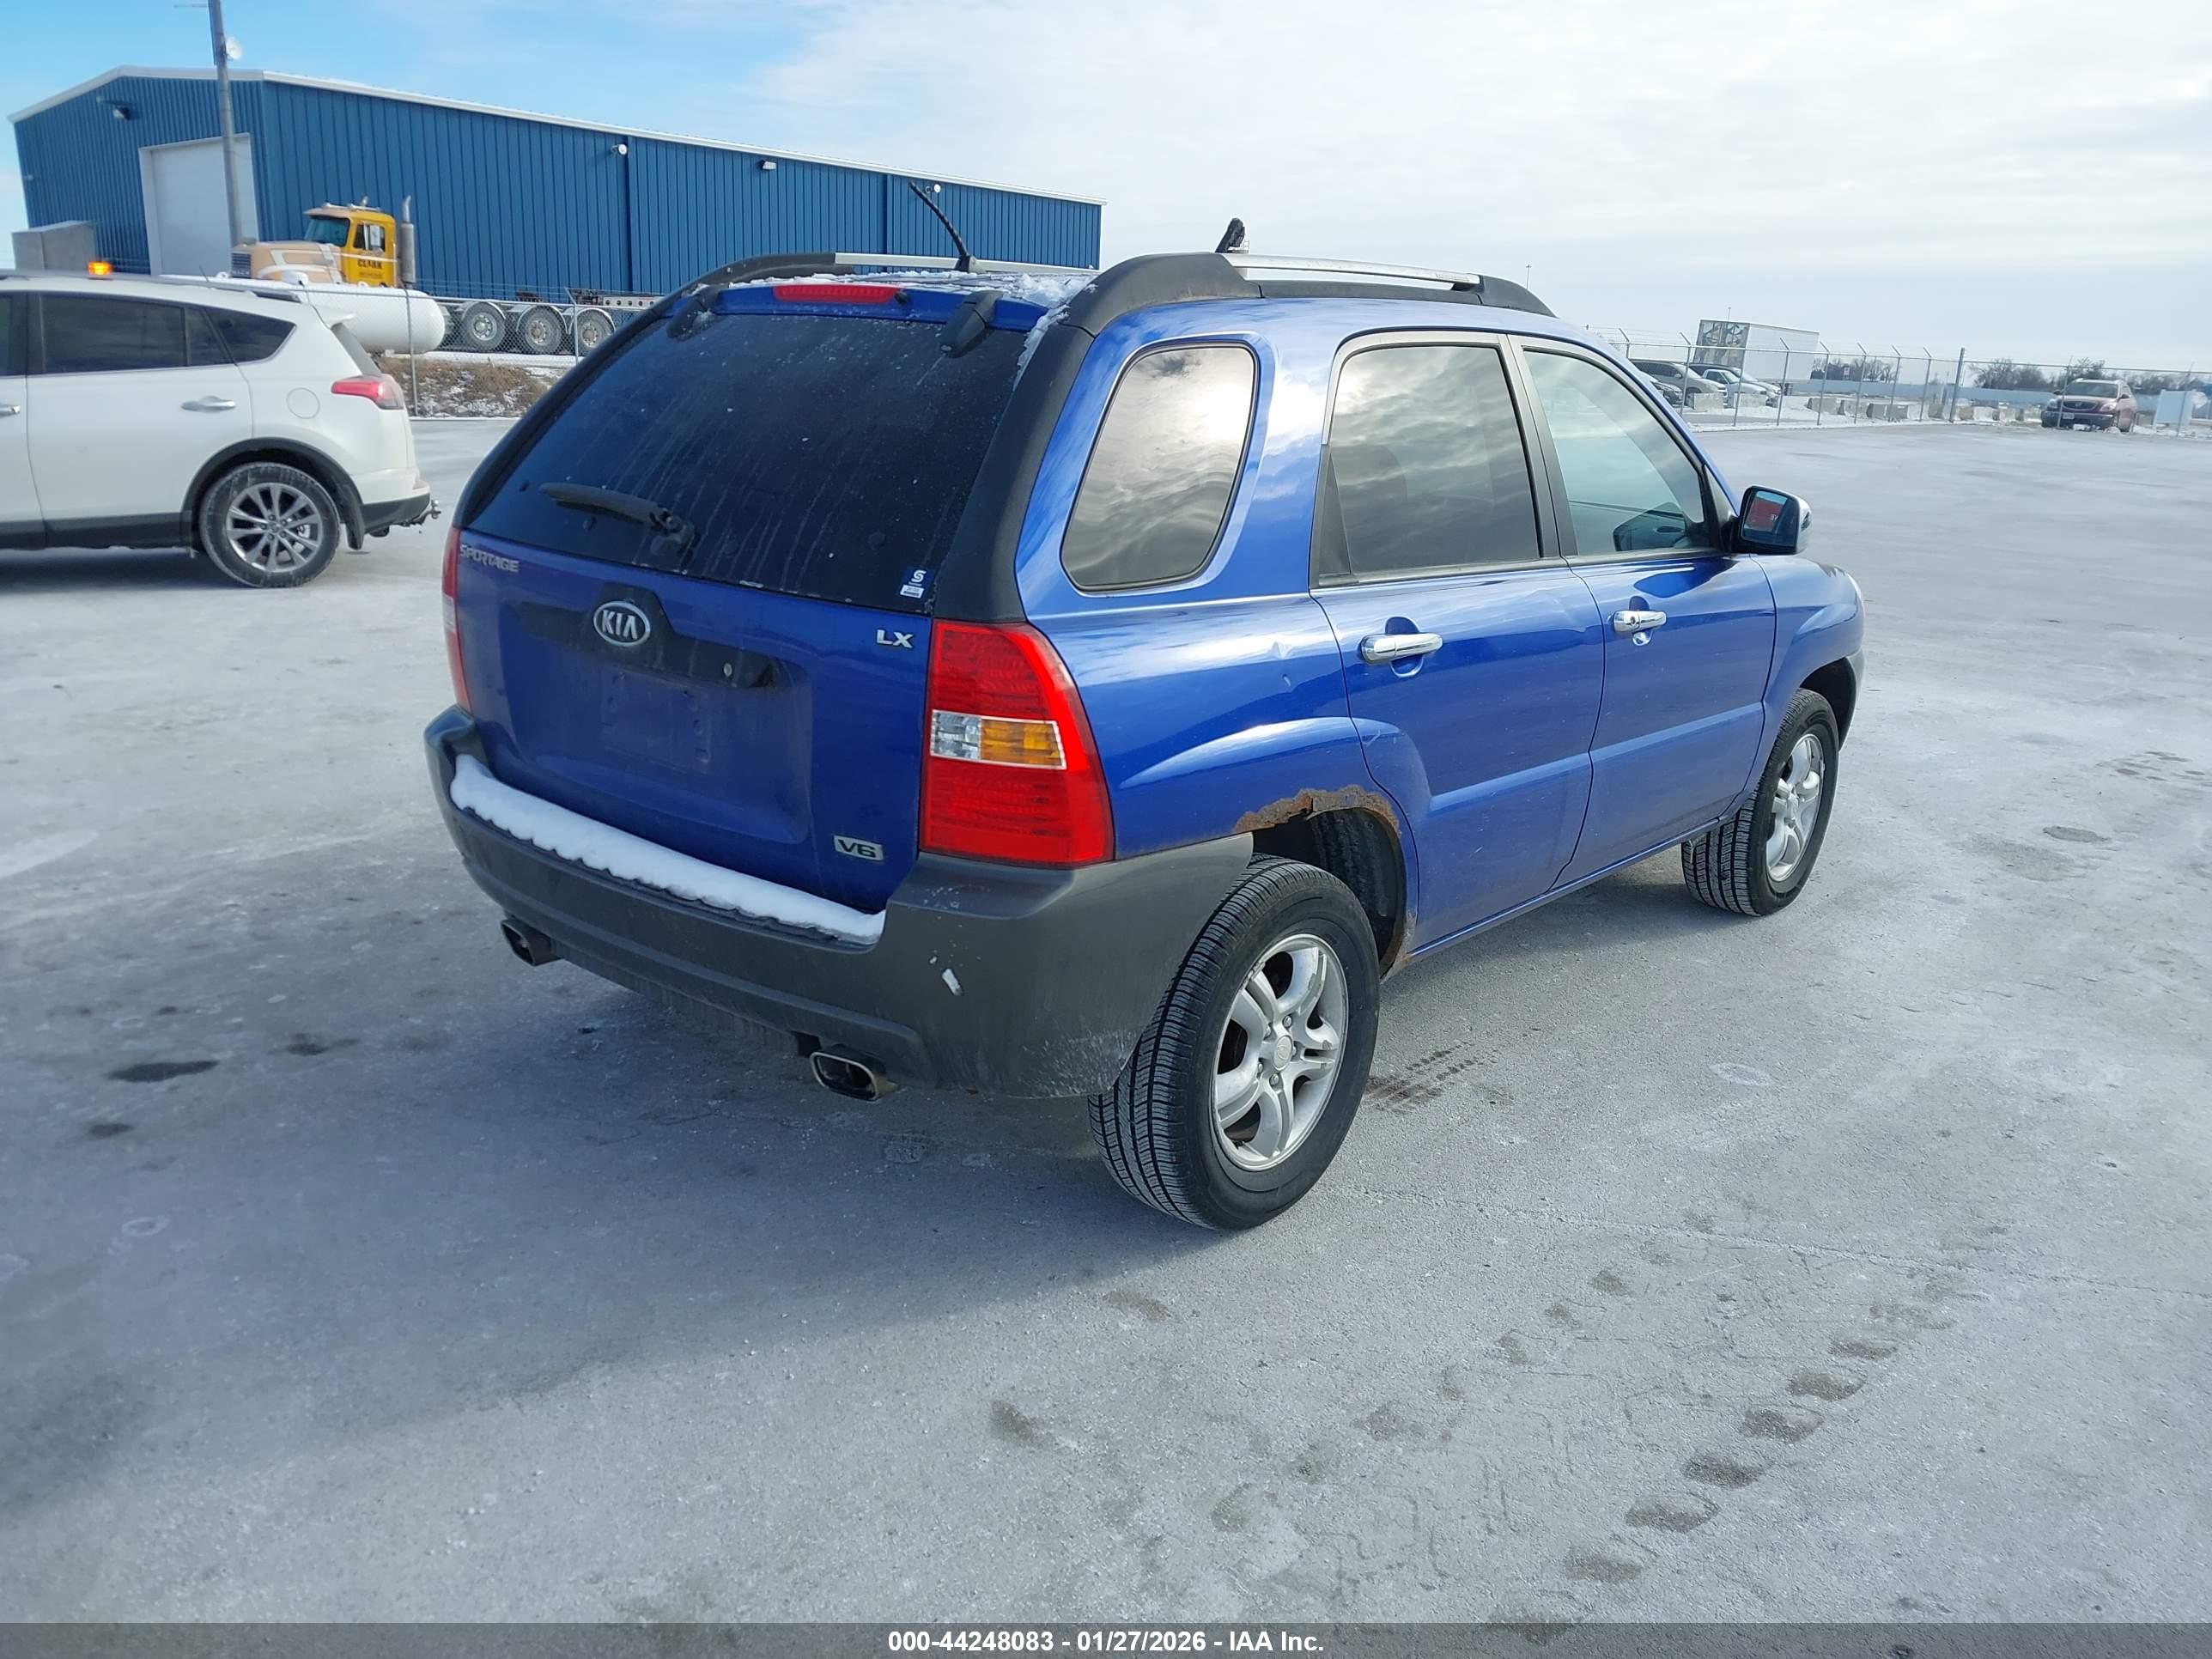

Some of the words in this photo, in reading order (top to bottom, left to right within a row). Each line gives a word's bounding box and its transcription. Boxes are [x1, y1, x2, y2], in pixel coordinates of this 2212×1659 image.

[460, 544, 520, 573] SPORTAGE
[602, 609, 638, 640] KIA
[876, 629, 915, 649] LX
[837, 838, 877, 858] V6
